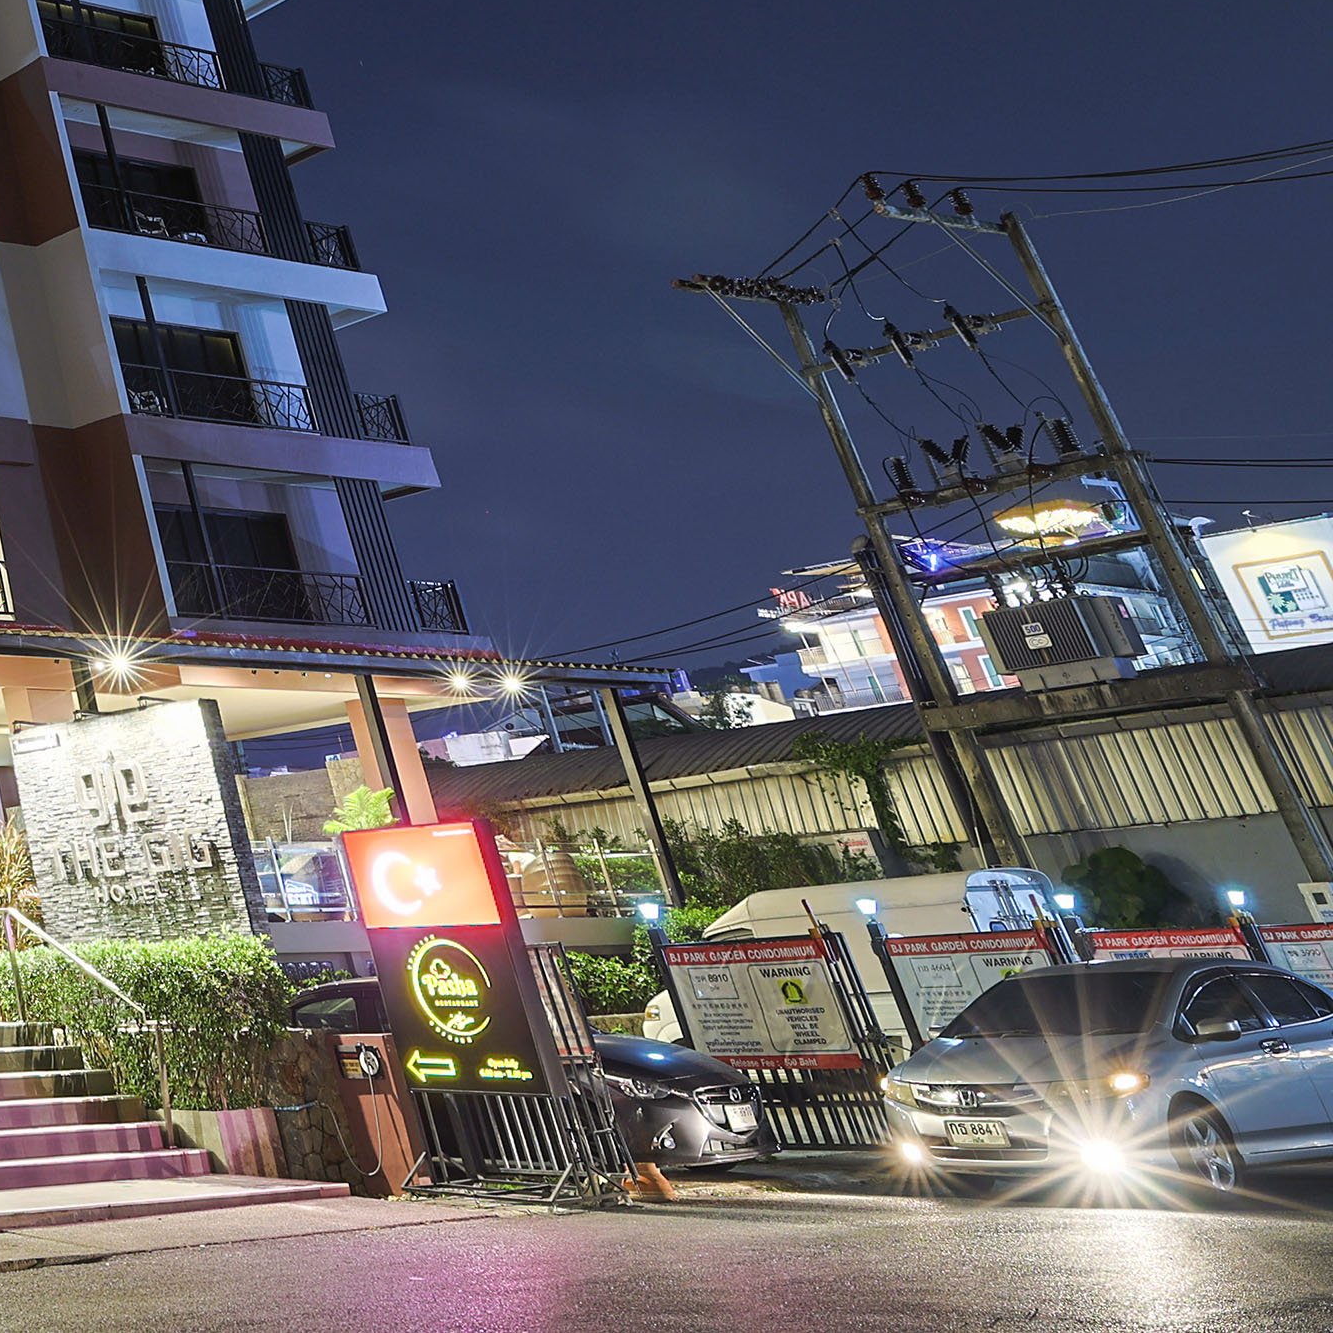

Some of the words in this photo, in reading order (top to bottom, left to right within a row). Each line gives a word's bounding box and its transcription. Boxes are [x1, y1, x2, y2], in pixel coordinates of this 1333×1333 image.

[1024, 623, 1042, 634] 500
[39, 834, 126, 881] THE
[141, 827, 213, 872] GIG
[94, 882, 170, 904] HOTEL
[1105, 936, 1129, 947] PARK
[1131, 935, 1168, 946] GARDEN
[1171, 932, 1237, 945] CONDOMINIUM
[1262, 932, 1275, 941] BJ
[1275, 931, 1300, 941] PARK
[890, 944, 903, 954] BJ
[905, 942, 929, 953] PARK
[931, 941, 968, 951] GARDEN
[970, 937, 1037, 949] CONDOMINIUM
[669, 953, 680, 963] BJ
[683, 950, 707, 963] PARK
[709, 948, 746, 961] GARDEN
[748, 946, 816, 960] CONDOMINIUM
[982, 956, 1034, 967] WARNING
[760, 966, 811, 978] WARNING
[421, 972, 478, 997] Pasha
[786, 1015, 819, 1023] VEHICLES
[791, 1023, 809, 1031] WILL
[793, 1037, 827, 1046] CLAMPED
[730, 1058, 760, 1067] Release
[761, 1057, 775, 1067] Fee
[798, 1057, 819, 1066] Baht
[970, 1122, 1000, 1136] 8841
